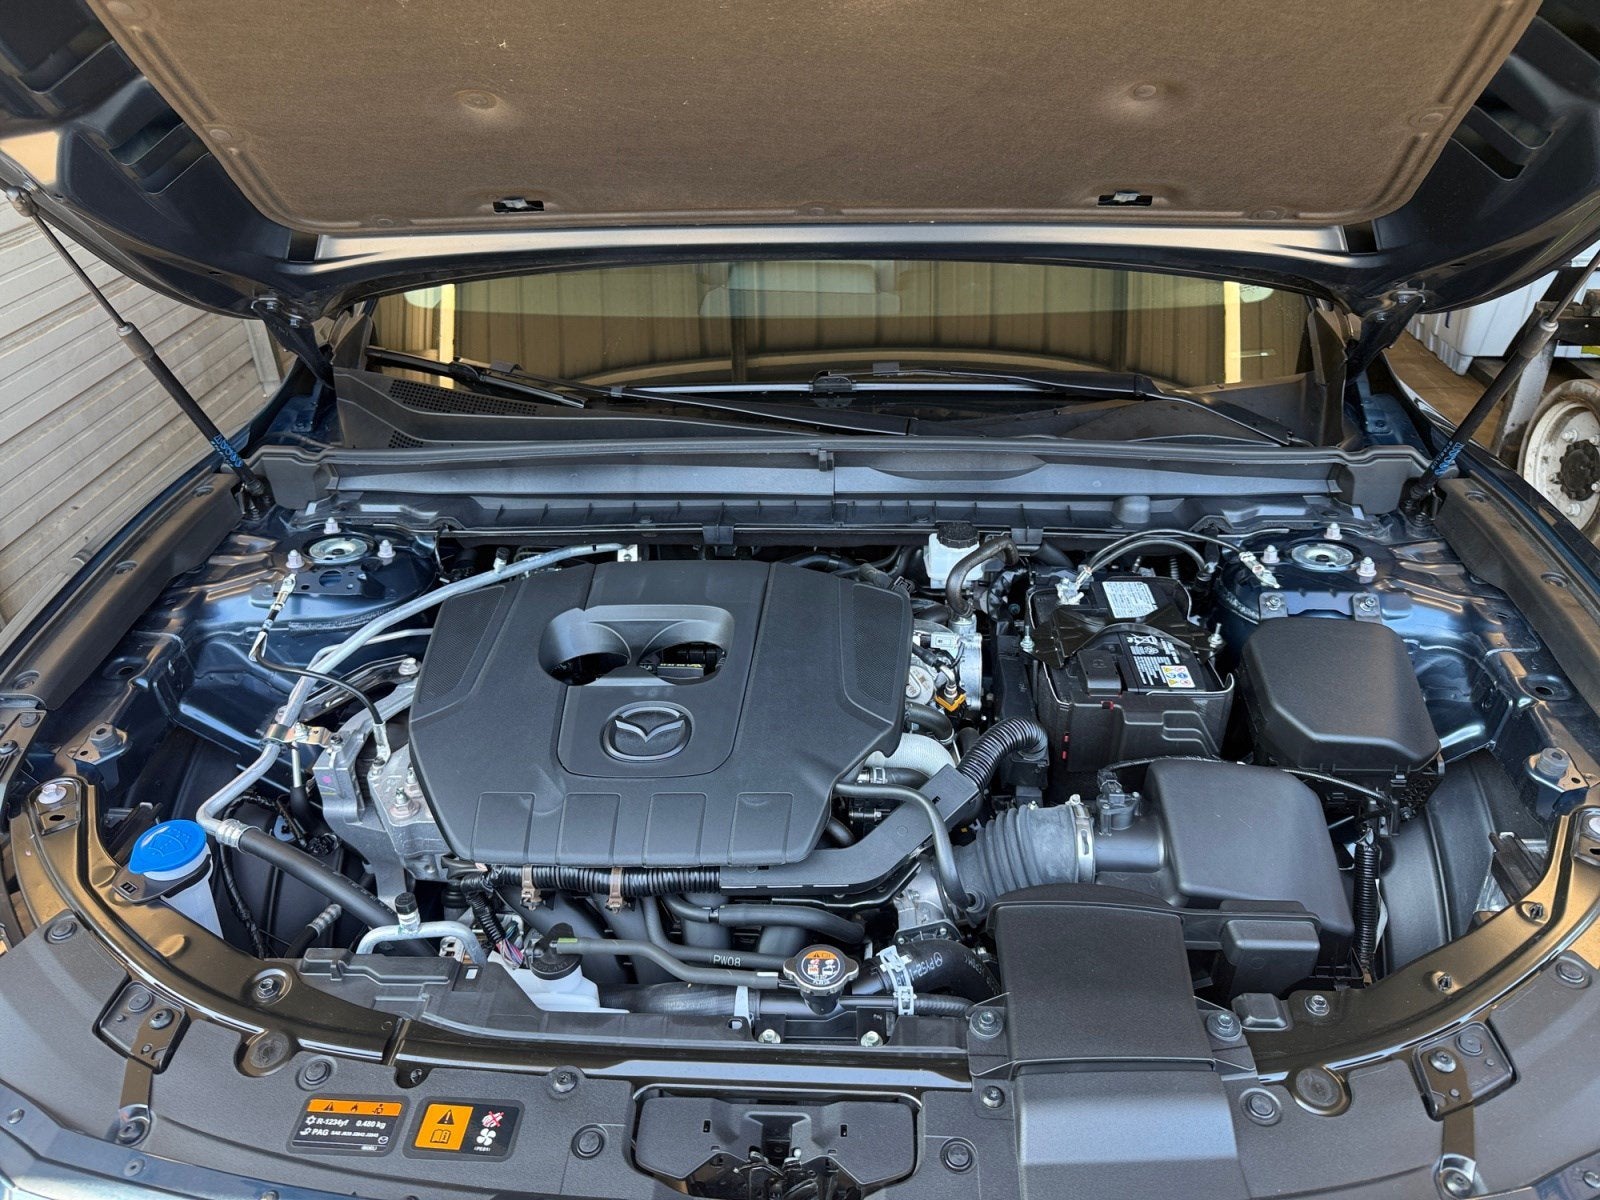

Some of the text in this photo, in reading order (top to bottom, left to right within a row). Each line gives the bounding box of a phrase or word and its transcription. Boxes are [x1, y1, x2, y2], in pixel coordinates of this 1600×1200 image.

[713, 954, 741, 967] PW08
[315, 1117, 350, 1128] R-1234yf
[376, 1121, 387, 1130] kg
[311, 1128, 329, 1136] PAG
